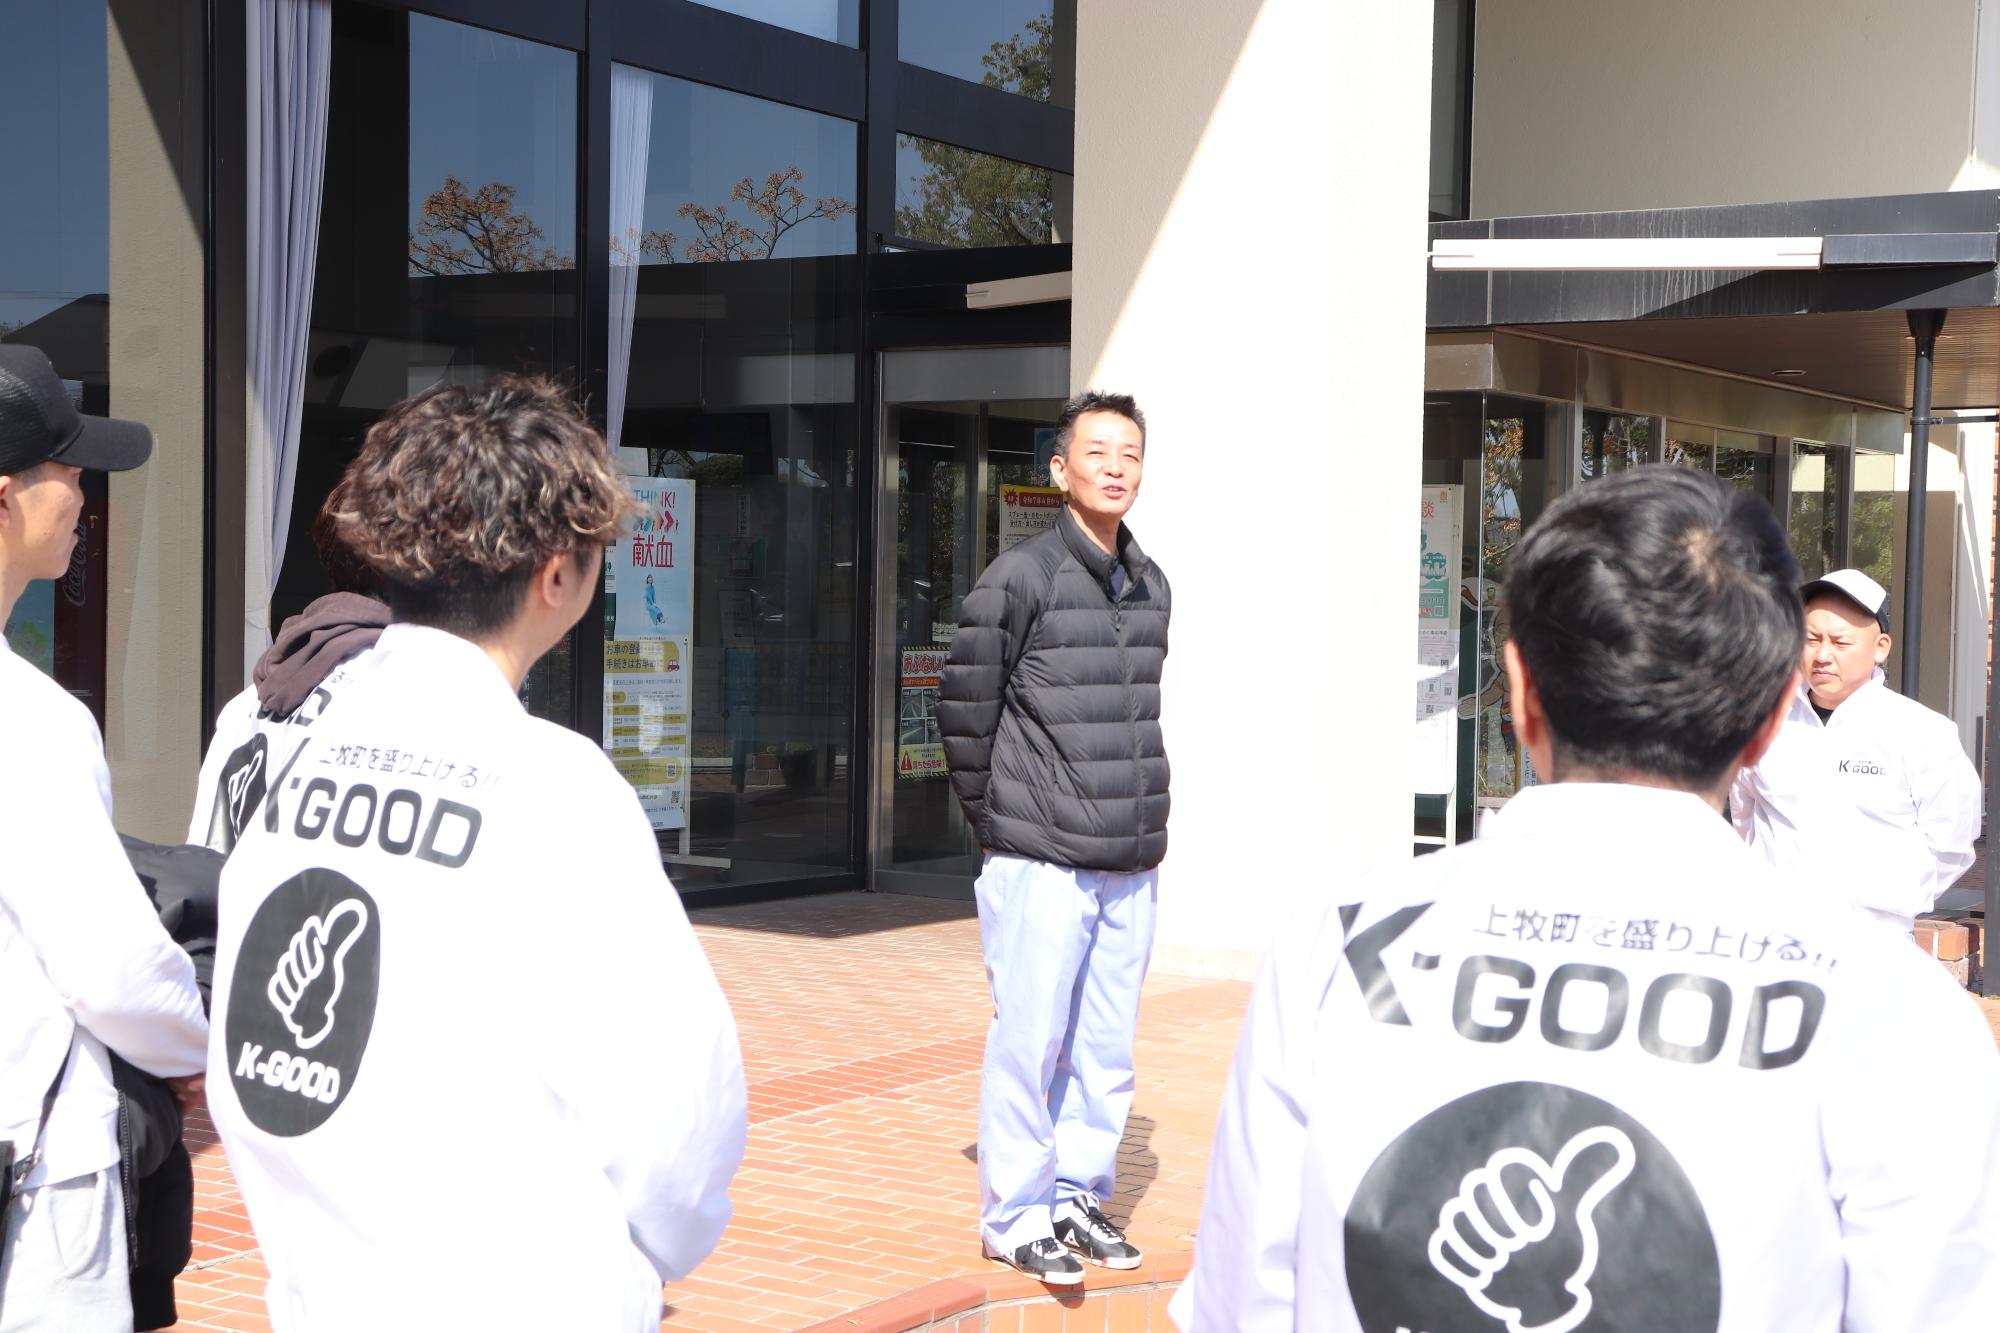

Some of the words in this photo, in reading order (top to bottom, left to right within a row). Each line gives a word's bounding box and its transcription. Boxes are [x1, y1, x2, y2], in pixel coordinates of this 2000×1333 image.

[632, 534, 674, 568] 献血
[1338, 900, 1827, 1070] K-GOOD
[235, 1042, 340, 1104] K-GOOD
